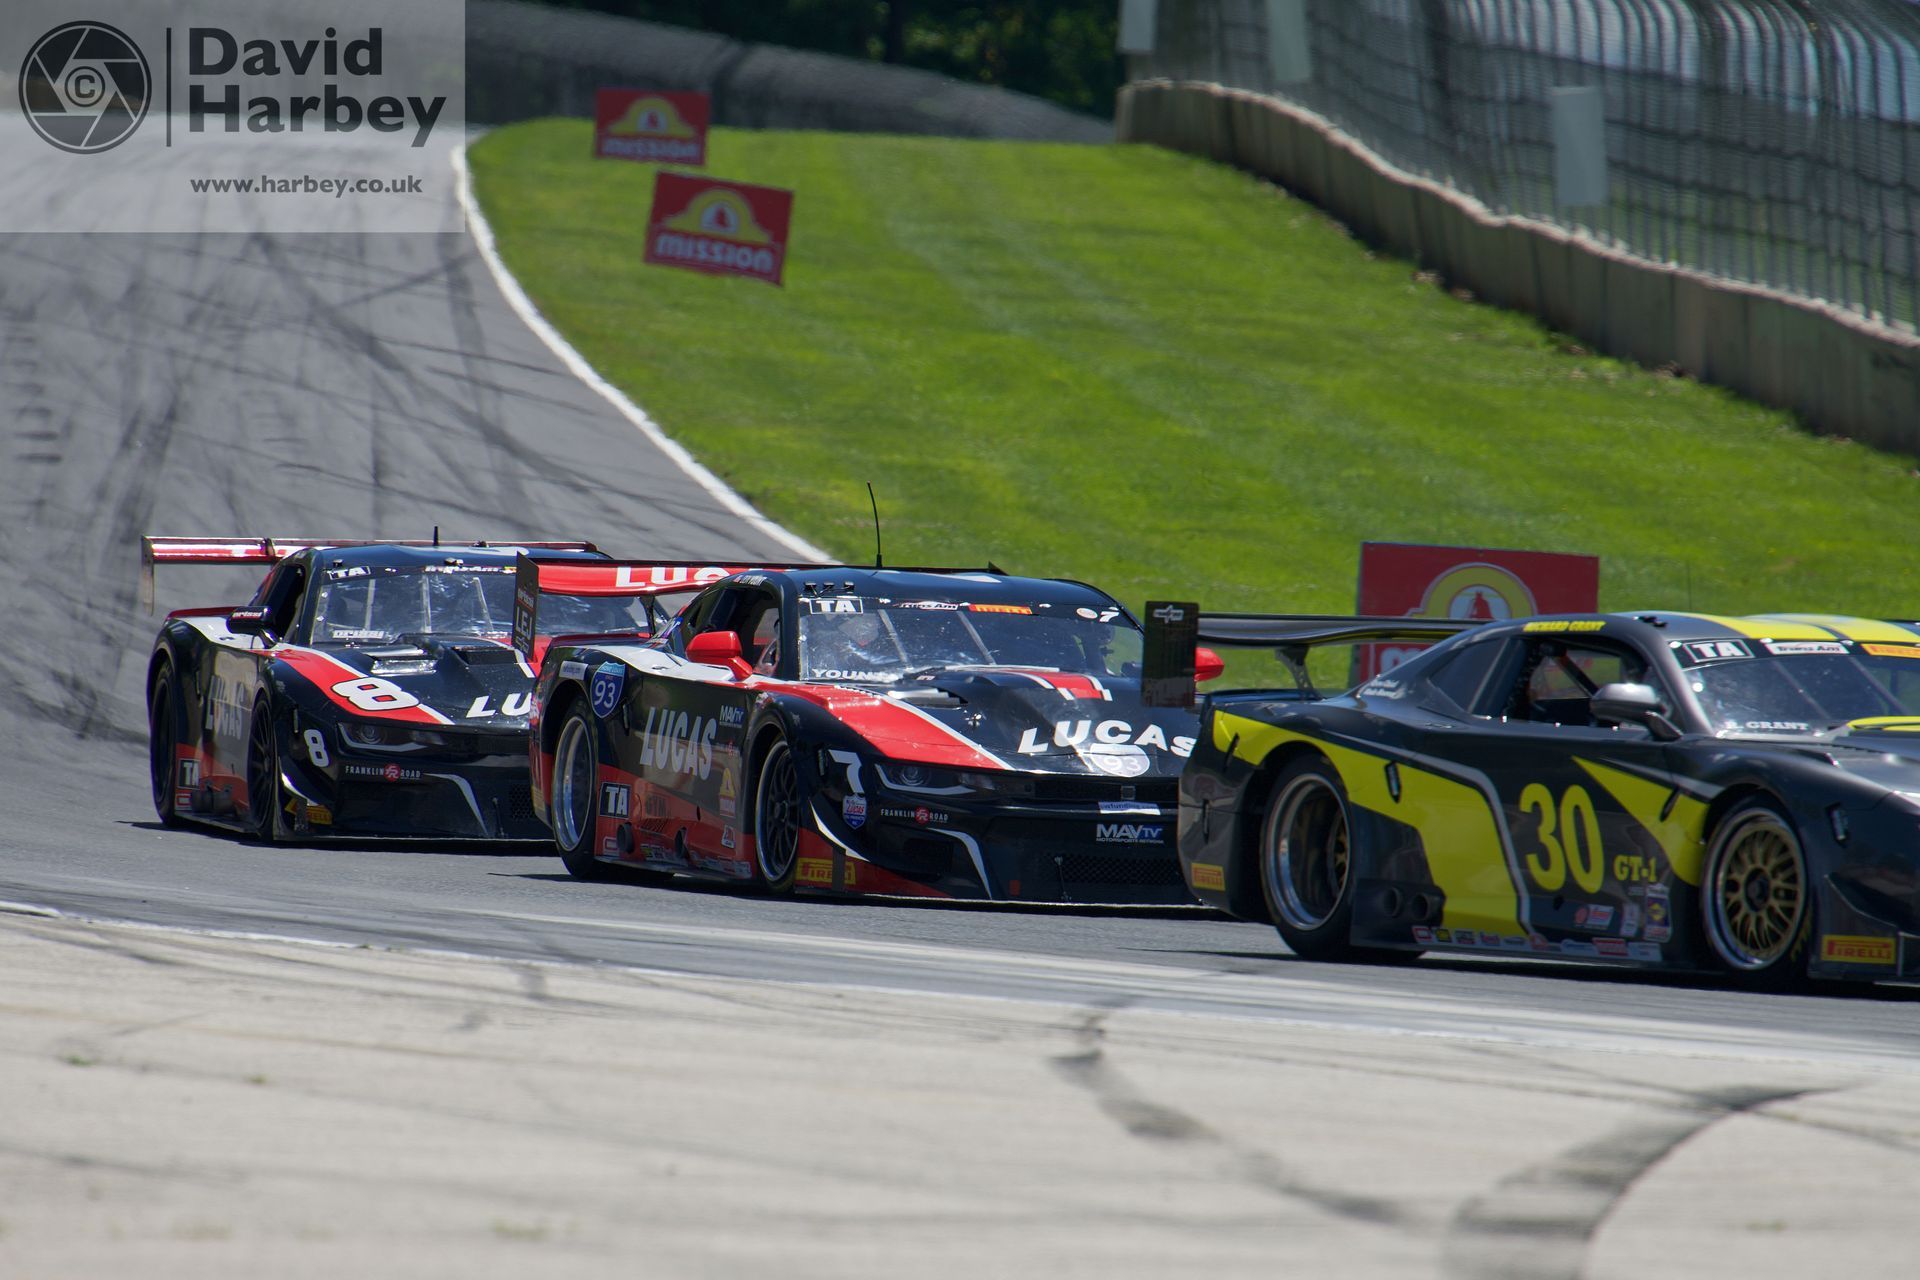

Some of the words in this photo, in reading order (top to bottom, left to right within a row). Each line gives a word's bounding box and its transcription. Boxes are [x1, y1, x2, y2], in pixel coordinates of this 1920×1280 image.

[815, 600, 857, 613] TA
[1099, 611, 1120, 623] 7
[1693, 642, 1746, 658] TA
[331, 676, 420, 711] 8
[594, 680, 616, 708] 93
[1018, 719, 1197, 758] LUCAS
[1746, 720, 1809, 731] GRANT
[304, 729, 329, 768] 8
[640, 706, 718, 781] LUCAS
[345, 765, 384, 776] FRANKLIN
[401, 768, 421, 778] ROAD
[828, 749, 865, 794] 7
[1103, 756, 1142, 771] 93
[605, 786, 629, 816] TA
[880, 808, 915, 818] FRANKLIN
[930, 812, 949, 821] ROAD
[1520, 783, 1604, 894] 30
[1613, 854, 1657, 883] GT-1
[1827, 940, 1892, 960] PIRELLI
